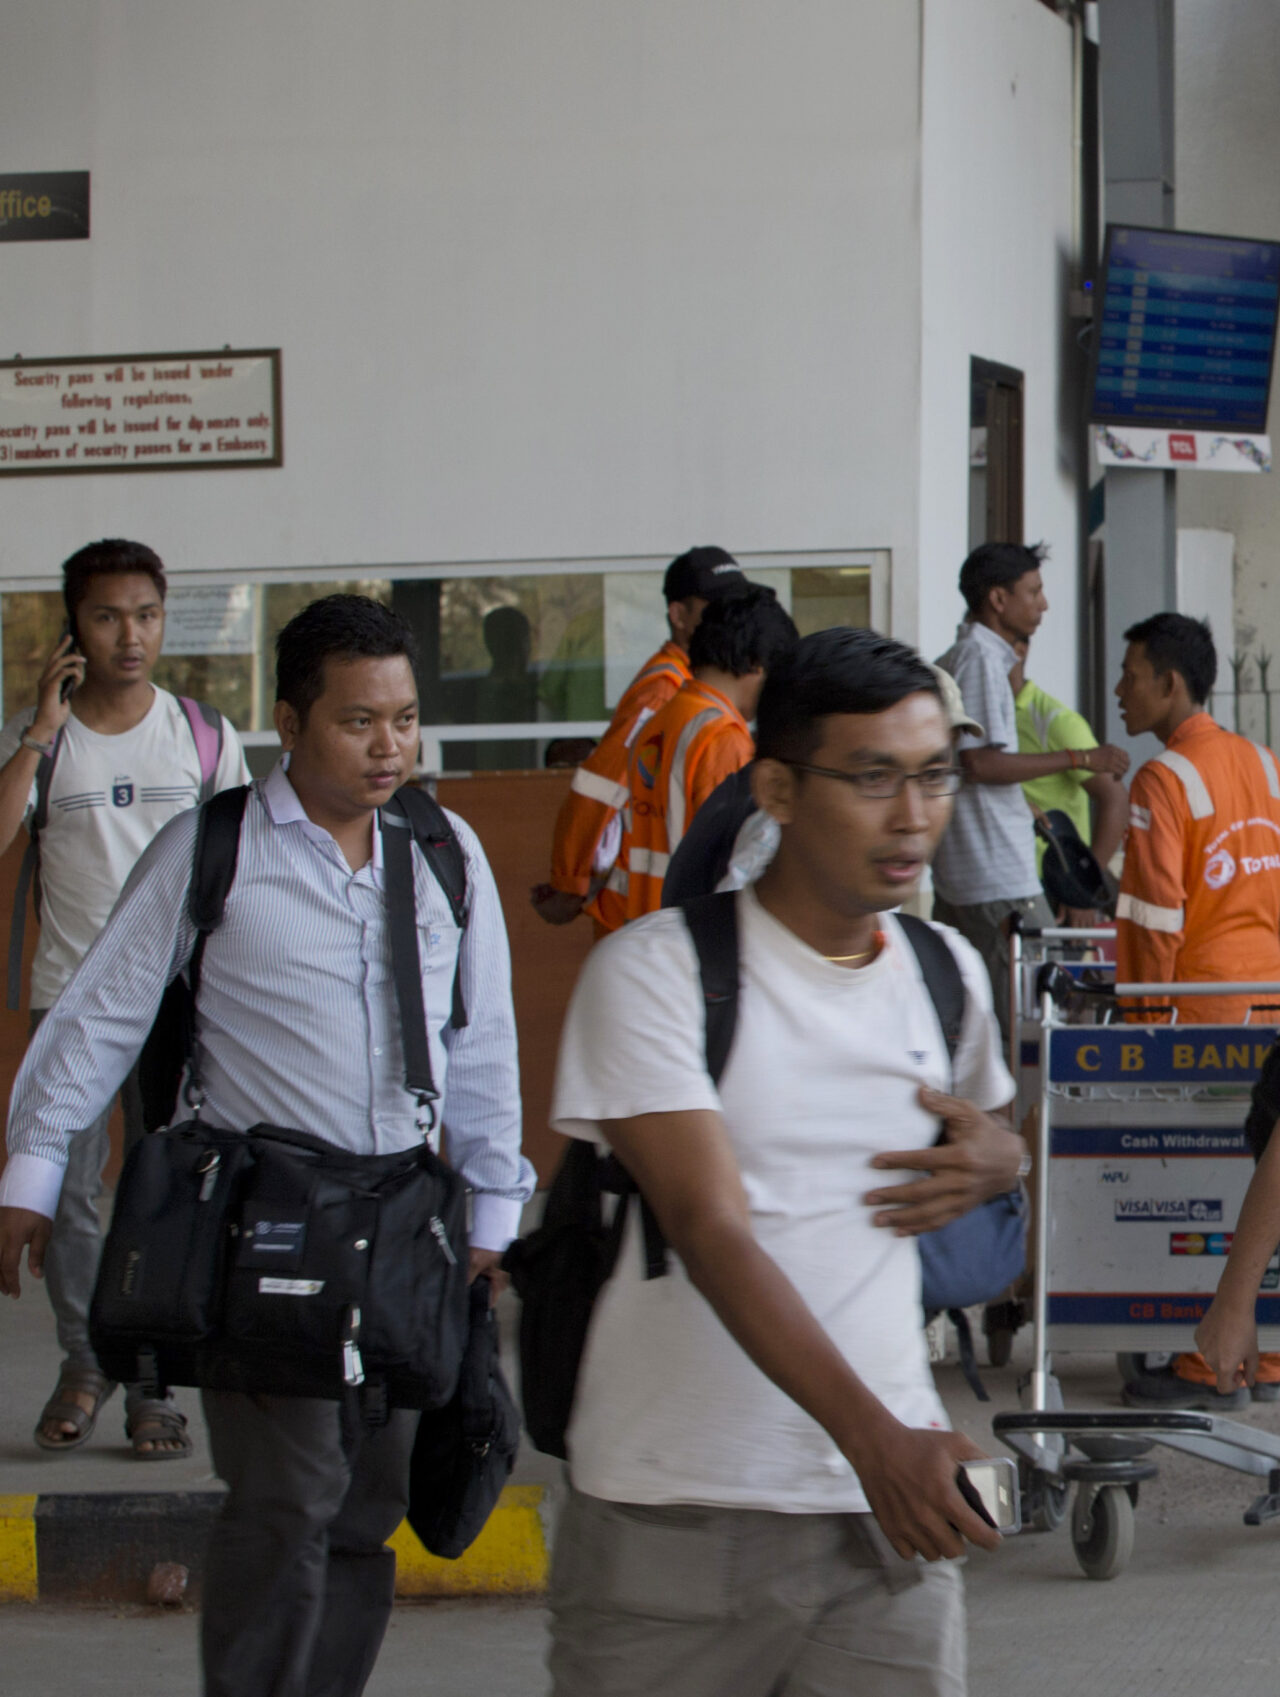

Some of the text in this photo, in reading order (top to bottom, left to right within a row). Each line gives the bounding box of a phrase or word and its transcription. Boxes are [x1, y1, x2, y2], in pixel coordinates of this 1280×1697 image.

[14, 362, 234, 389] Security pass will be issued under
[61, 393, 112, 411] following
[45, 425, 71, 441] pass
[78, 418, 97, 435] will
[103, 418, 117, 434] be
[123, 415, 160, 433] issued
[166, 415, 182, 431] for
[188, 414, 241, 434] dipomats
[65, 442, 79, 459] of
[83, 443, 128, 460] security
[134, 443, 172, 459] passes
[178, 437, 193, 453] for
[199, 441, 213, 453] an
[1171, 440, 1194, 455] TCL
[1076, 1043, 1273, 1072] C B BANK
[1121, 1134, 1245, 1149] Cash Withdrawal
[1119, 1201, 1150, 1213] VISA
[1155, 1201, 1186, 1213] VISA
[1129, 1303, 1204, 1318] CB Bank
